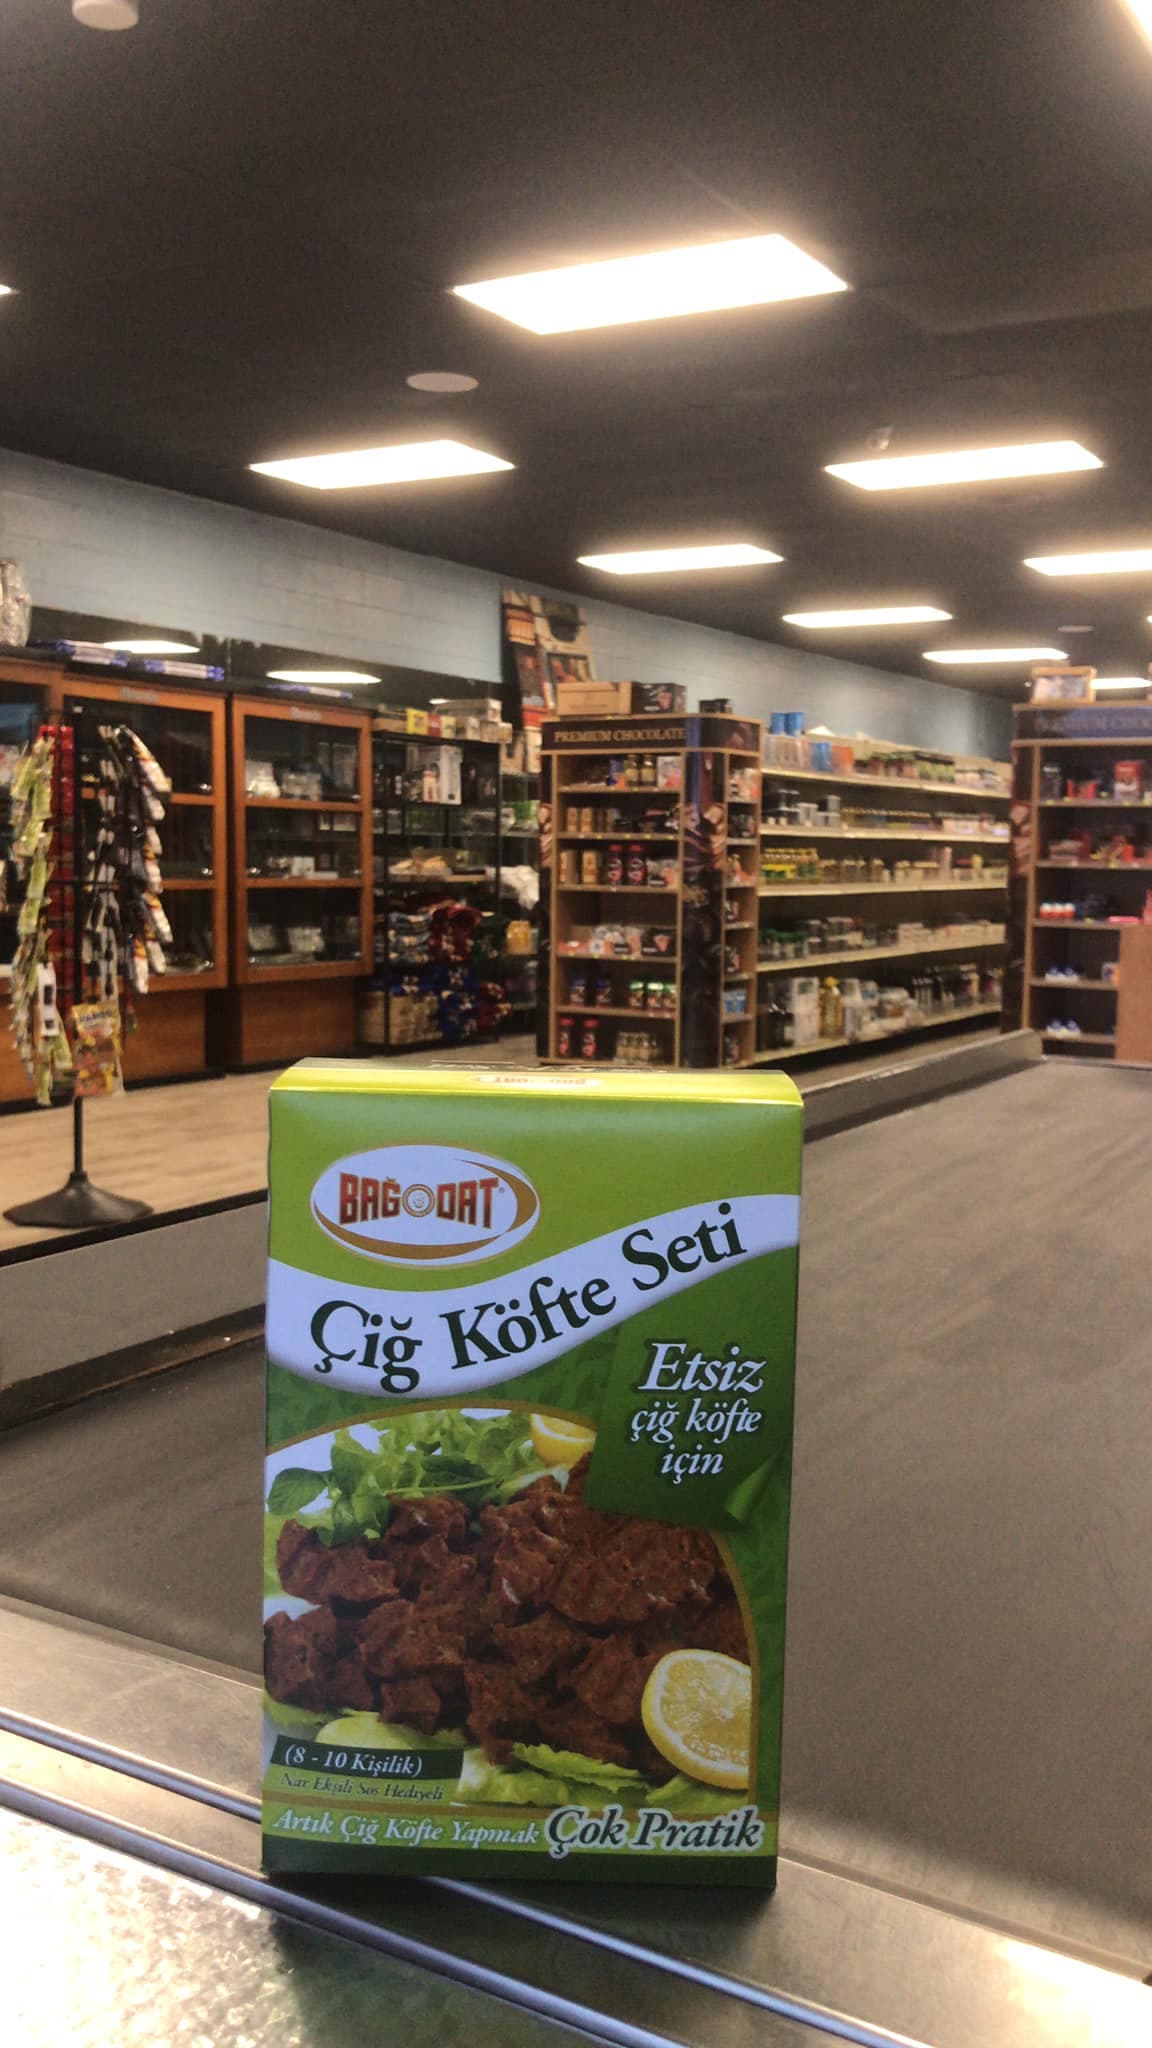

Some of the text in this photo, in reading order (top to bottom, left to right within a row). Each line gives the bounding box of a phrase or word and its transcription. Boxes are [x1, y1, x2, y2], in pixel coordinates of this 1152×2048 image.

[310, 1202, 747, 1393] Çiğ Köfte Seti
[638, 1343, 767, 1393] Etsiz
[631, 1398, 762, 1444] çiğ köfte
[661, 1444, 724, 1484] için
[323, 1751, 347, 1769] 10
[351, 1753, 423, 1777] Kişilik)
[281, 1773, 444, 1803] Nar Ekşili Sos Hediyeli
[273, 1807, 761, 1856] Artık Çiğ Köfte Yapmak Çok Pratik
